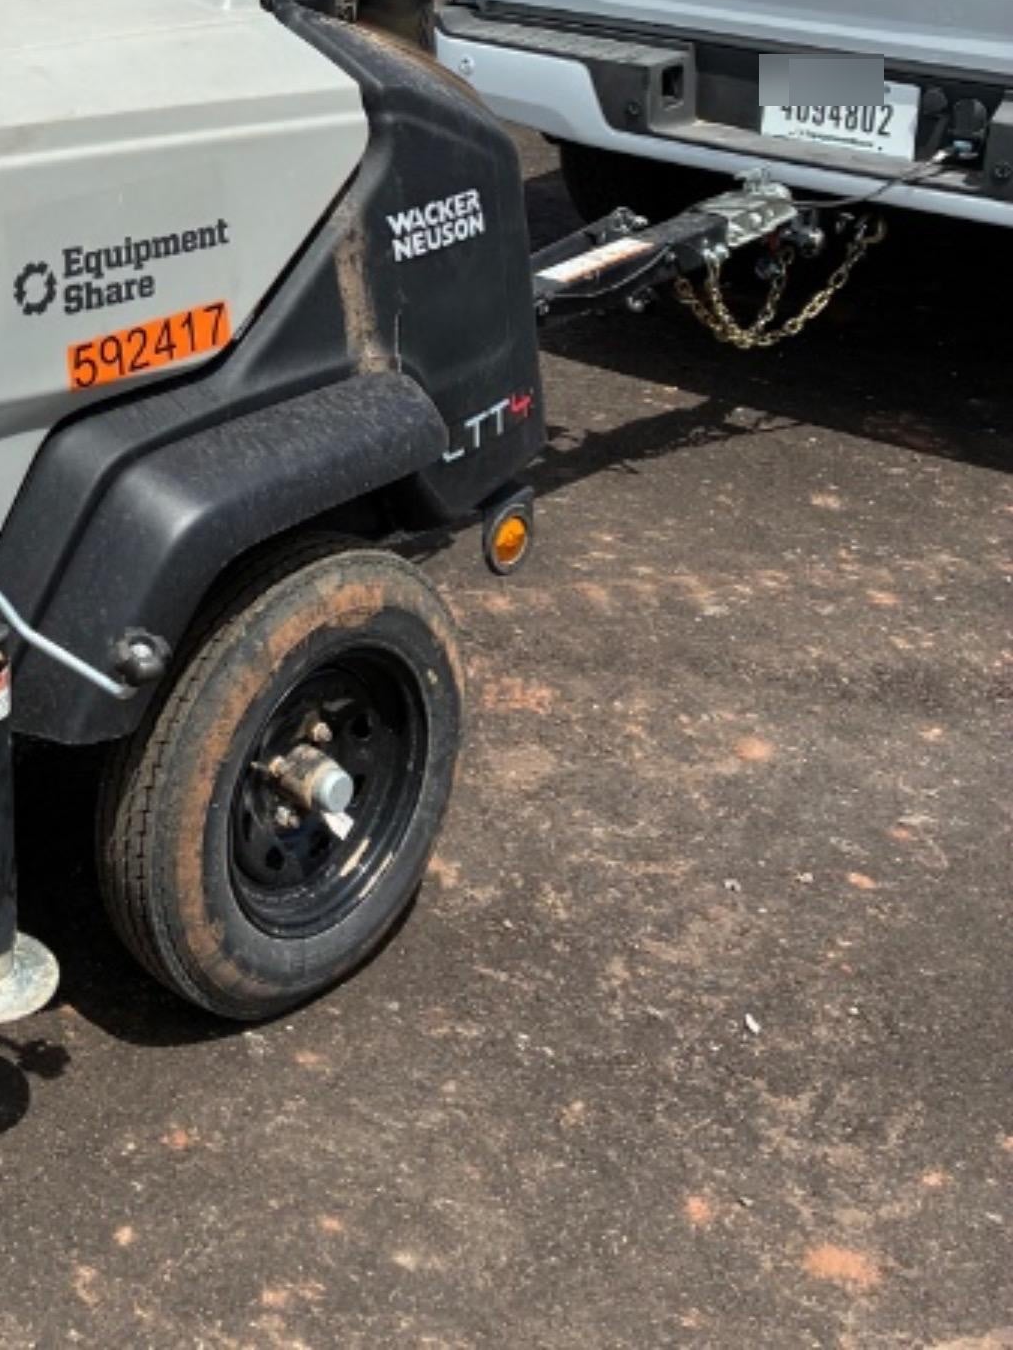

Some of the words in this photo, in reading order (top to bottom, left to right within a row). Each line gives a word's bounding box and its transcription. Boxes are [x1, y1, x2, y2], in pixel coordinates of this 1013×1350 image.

[386, 189, 481, 236] WACKER
[392, 212, 485, 263] NEUSON
[62, 218, 230, 280] Equipment
[63, 274, 156, 315] Share
[72, 302, 226, 389] 592417
